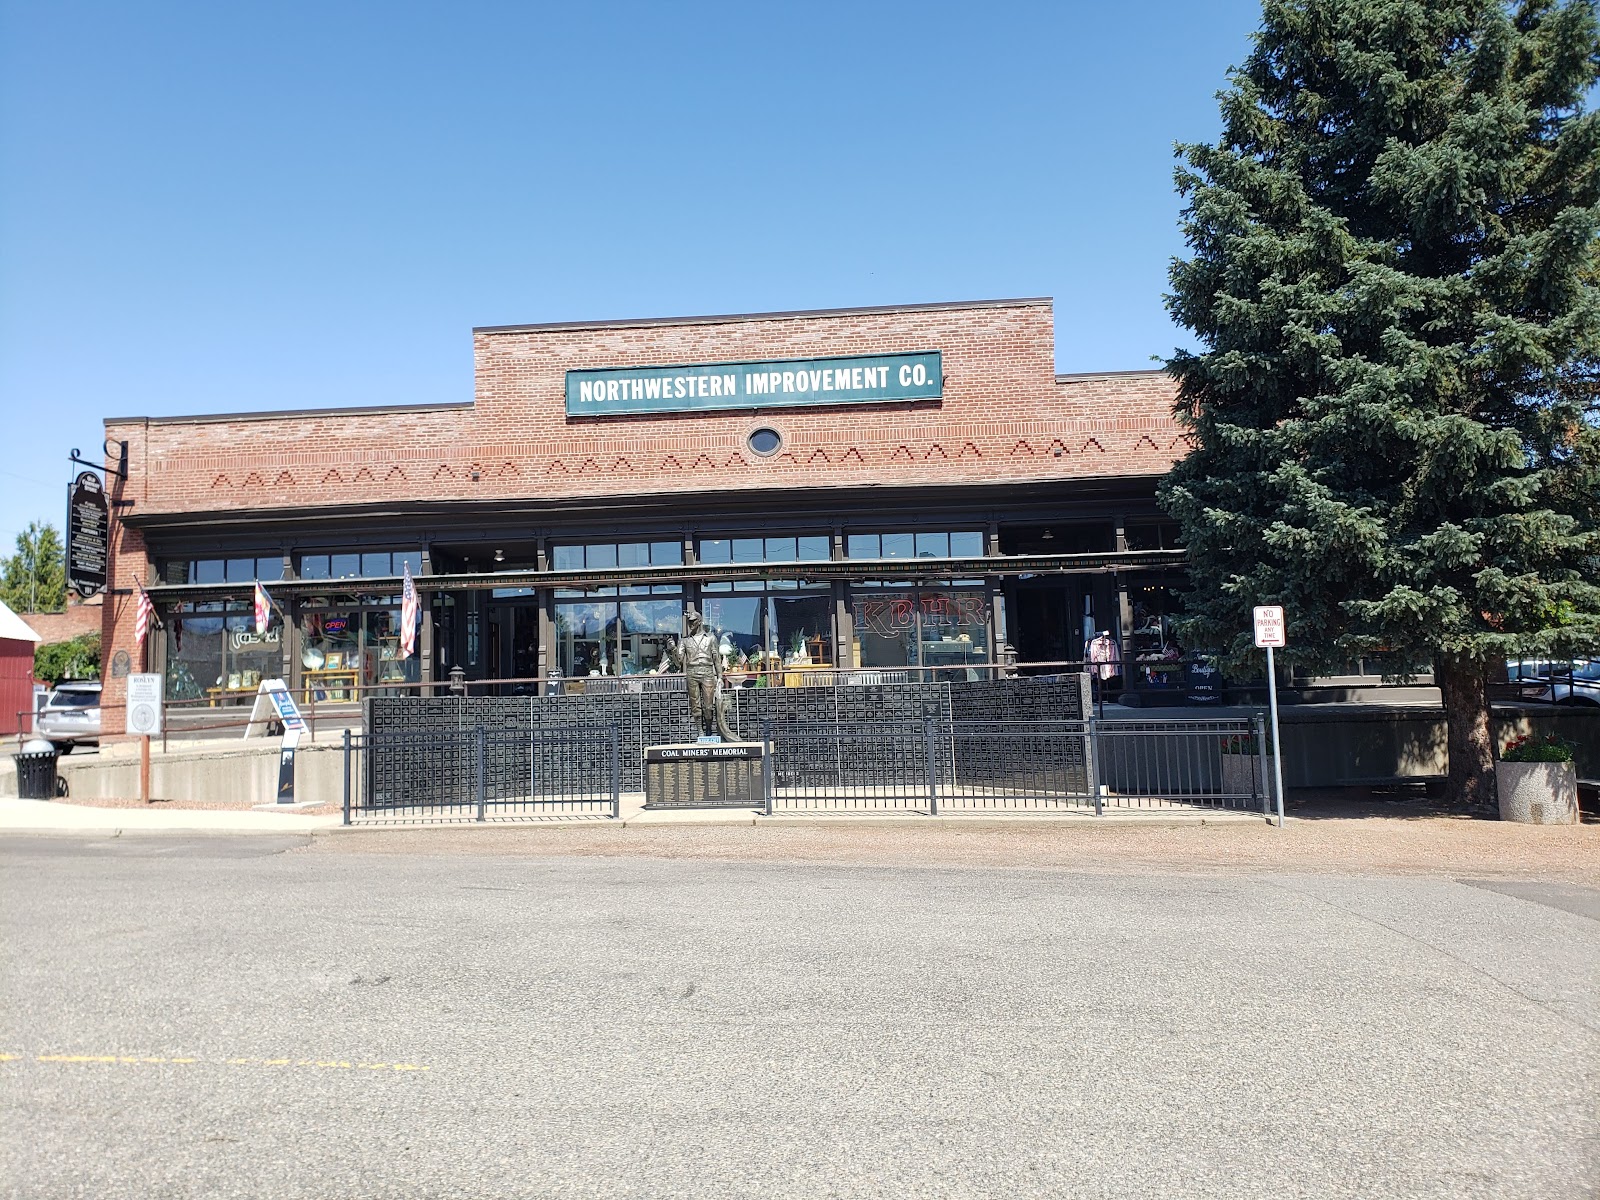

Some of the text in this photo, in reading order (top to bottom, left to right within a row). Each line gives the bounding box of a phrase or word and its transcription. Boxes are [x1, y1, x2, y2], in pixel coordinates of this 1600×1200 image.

[580, 363, 933, 402] NORTHWESTERN IMPROVEMENT CO.
[324, 621, 347, 629] OPEN
[852, 598, 985, 638] KBHR
[682, 749, 710, 757] MINERS'
[712, 748, 748, 756] MEMORIAL
